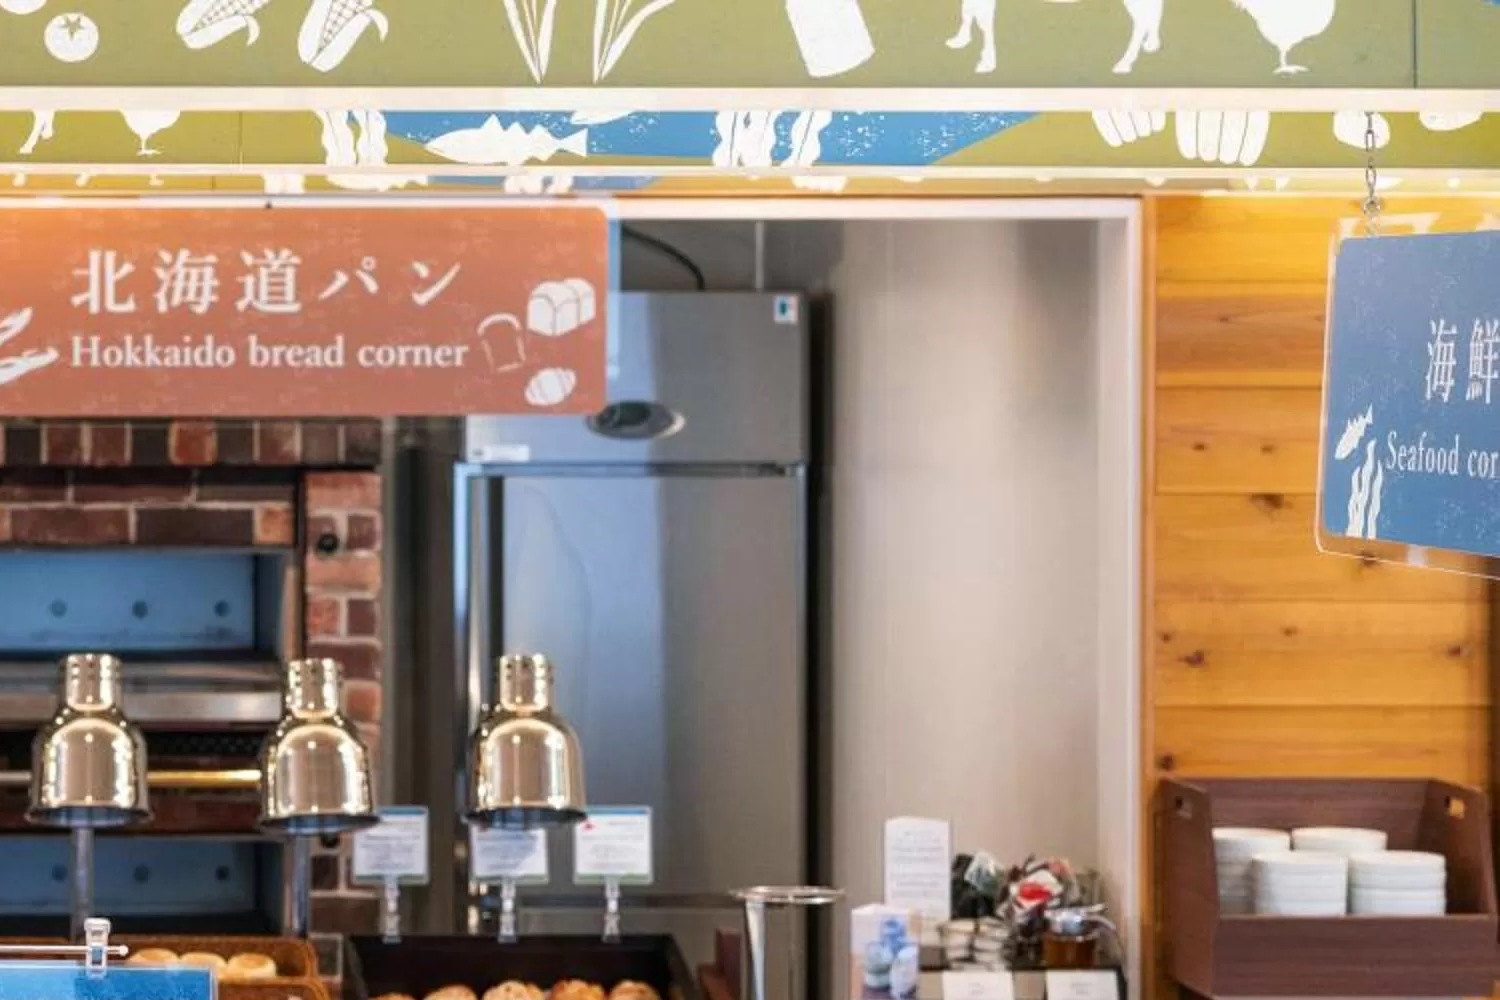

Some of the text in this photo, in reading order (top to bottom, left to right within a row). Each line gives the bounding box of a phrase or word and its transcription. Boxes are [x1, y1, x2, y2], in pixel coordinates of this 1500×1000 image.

[71, 248, 461, 315] 北海道パン
[70, 333, 469, 369] Hokkaido bread corner
[1424, 318, 1500, 405] 海鮮
[1386, 430, 1460, 475] Seafood
